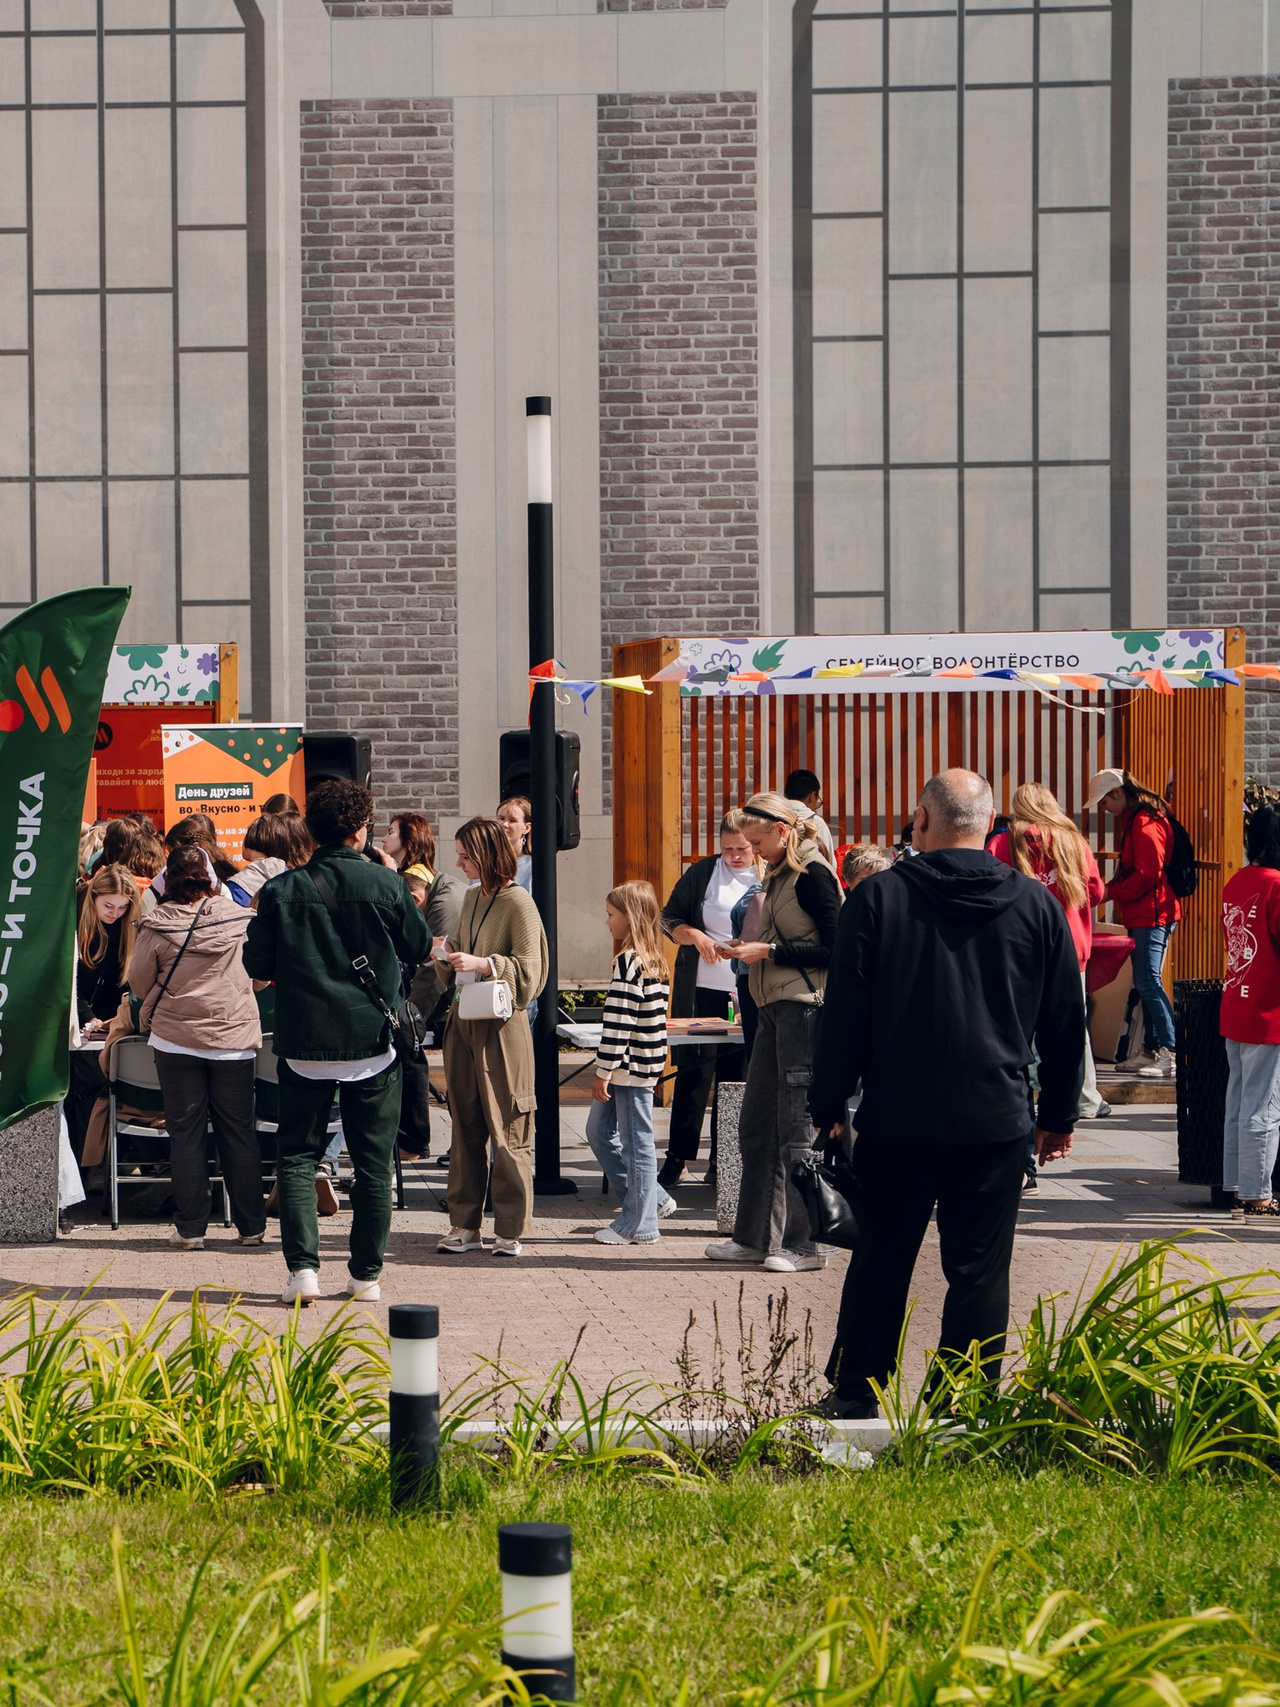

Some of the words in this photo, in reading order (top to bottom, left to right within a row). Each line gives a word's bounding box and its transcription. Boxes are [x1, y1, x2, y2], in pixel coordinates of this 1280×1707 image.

[933, 653, 1080, 669] ВОЛОНТЁРСТВО
[96, 768, 124, 777] иходи
[137, 767, 164, 777] зарпл
[145, 777, 164, 786] люб
[178, 786, 208, 799] День
[209, 784, 250, 799] друзей
[179, 806, 193, 815] во
[248, 804, 256, 813] и
[8, 771, 46, 904] ТОЧКА
[0, 913, 27, 940] И
